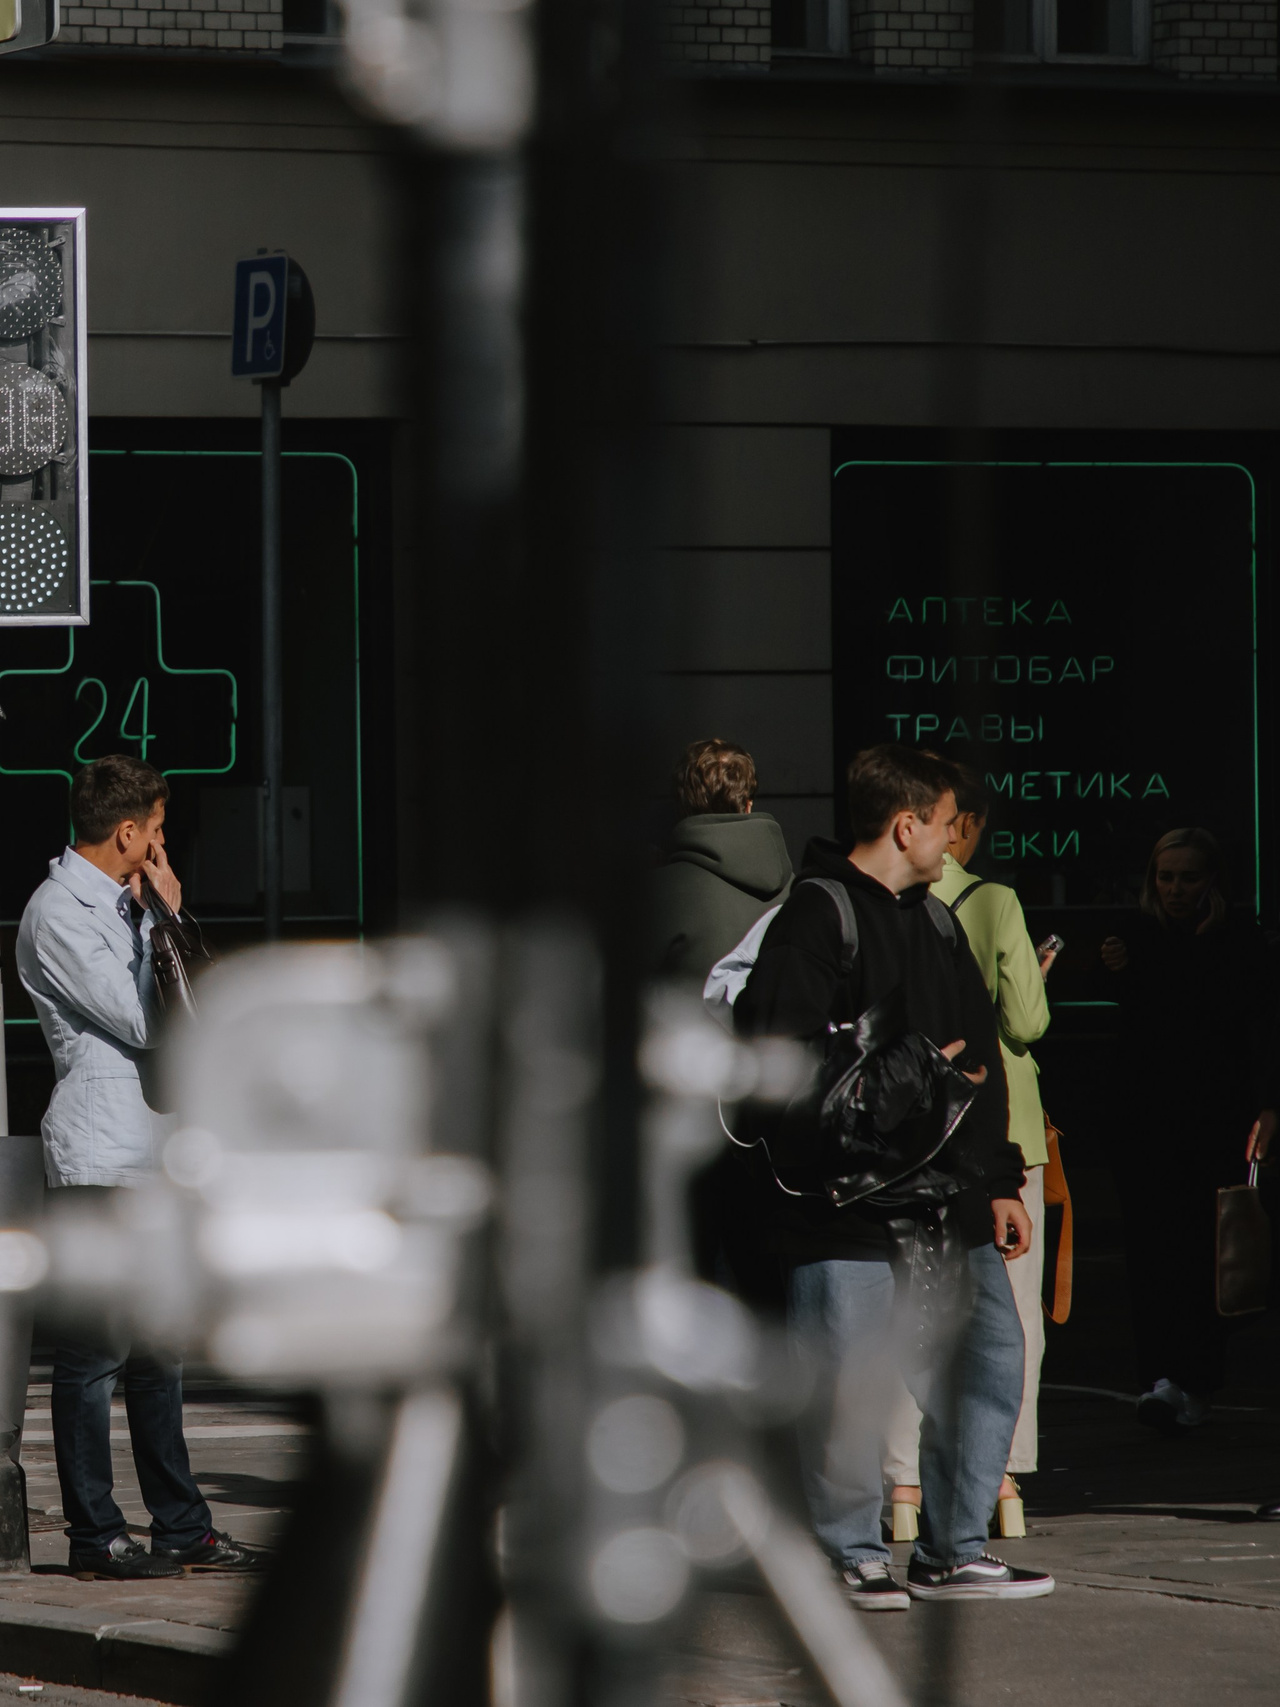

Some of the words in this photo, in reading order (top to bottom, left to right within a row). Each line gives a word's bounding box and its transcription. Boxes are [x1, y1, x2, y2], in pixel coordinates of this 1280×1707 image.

[246, 270, 276, 362] P
[886, 596, 1073, 626] АПТЕКА
[886, 655, 1116, 685] ФИТОБАР
[73, 676, 157, 764] 24
[885, 713, 1045, 743] ТРАВЫ
[984, 770, 1172, 801] МЕТИКА
